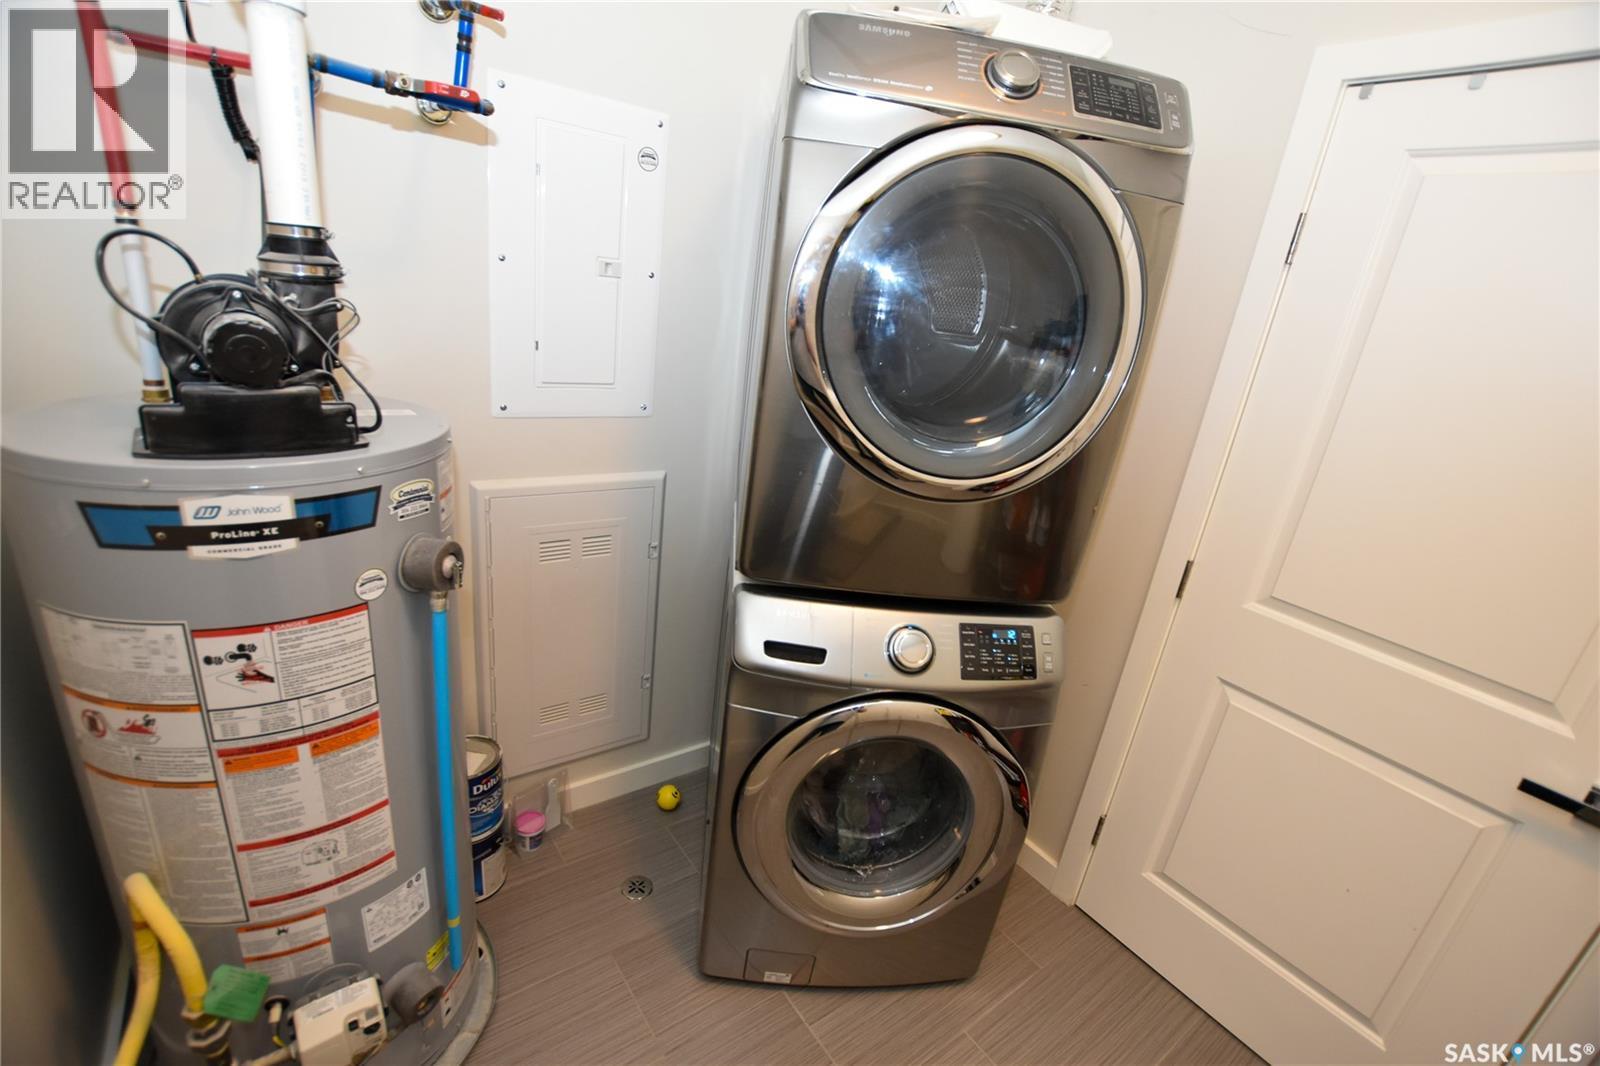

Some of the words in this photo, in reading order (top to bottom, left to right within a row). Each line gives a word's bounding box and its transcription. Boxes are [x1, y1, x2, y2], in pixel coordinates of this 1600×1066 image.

[226, 506, 251, 517] John
[261, 526, 280, 536] XE
[473, 776, 500, 796] Dulu
